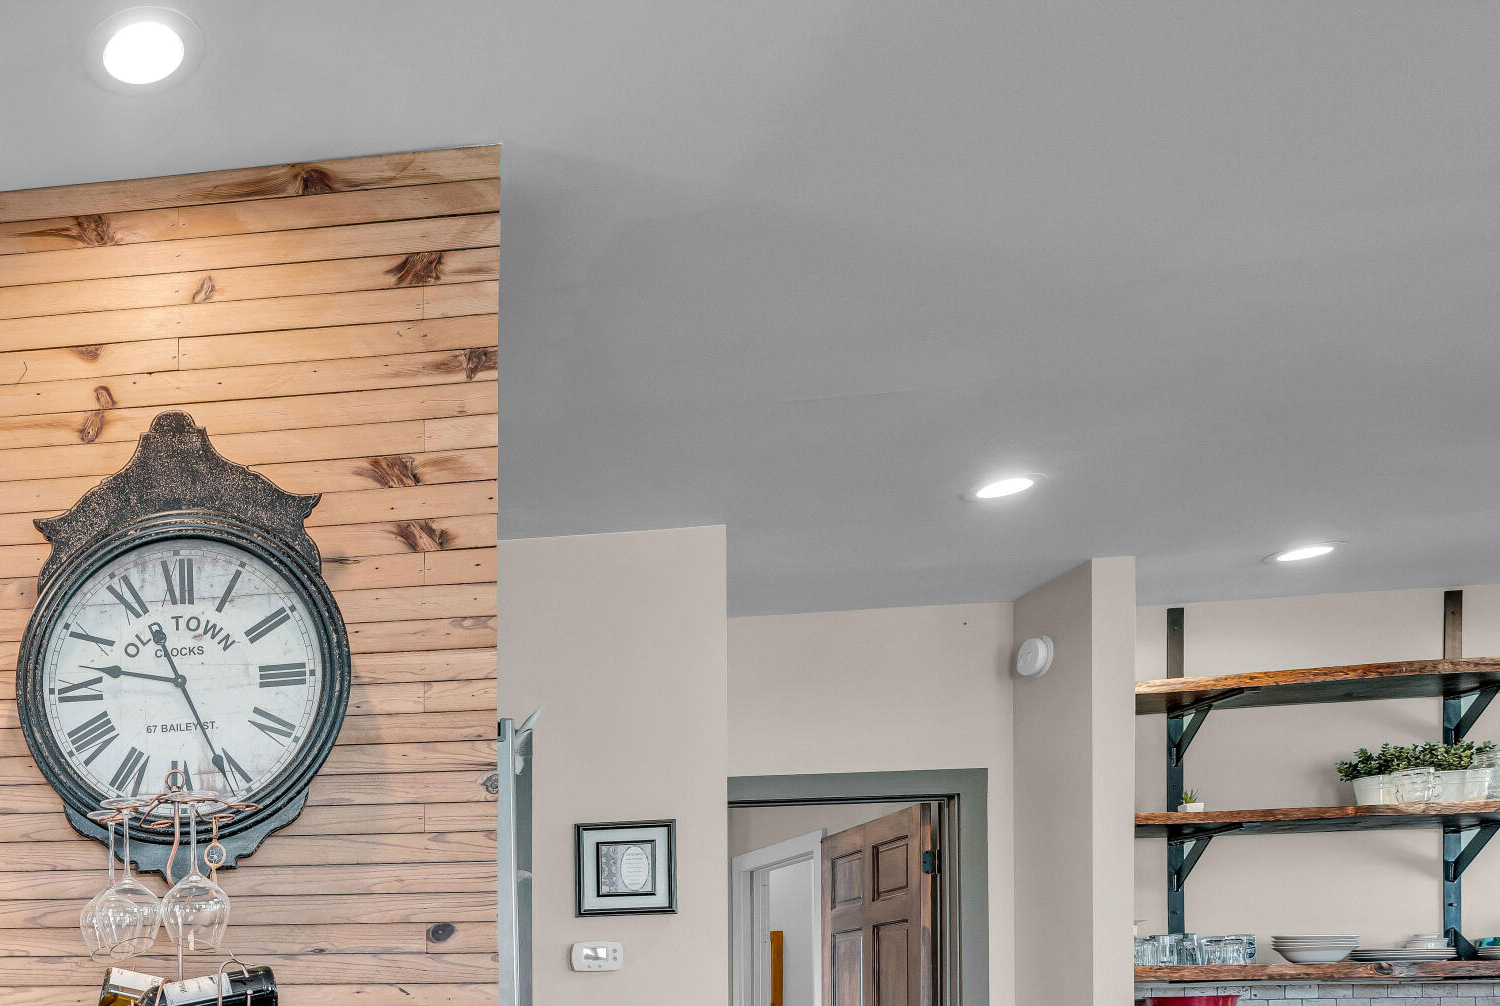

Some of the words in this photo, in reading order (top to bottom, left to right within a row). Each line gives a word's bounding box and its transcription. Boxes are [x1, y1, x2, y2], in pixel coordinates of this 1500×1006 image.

[124, 621, 164, 659] OLD
[170, 615, 237, 652] TOWN
[146, 724, 158, 734] 67
[160, 721, 200, 733] BAILEY
[202, 720, 219, 730] ST.
